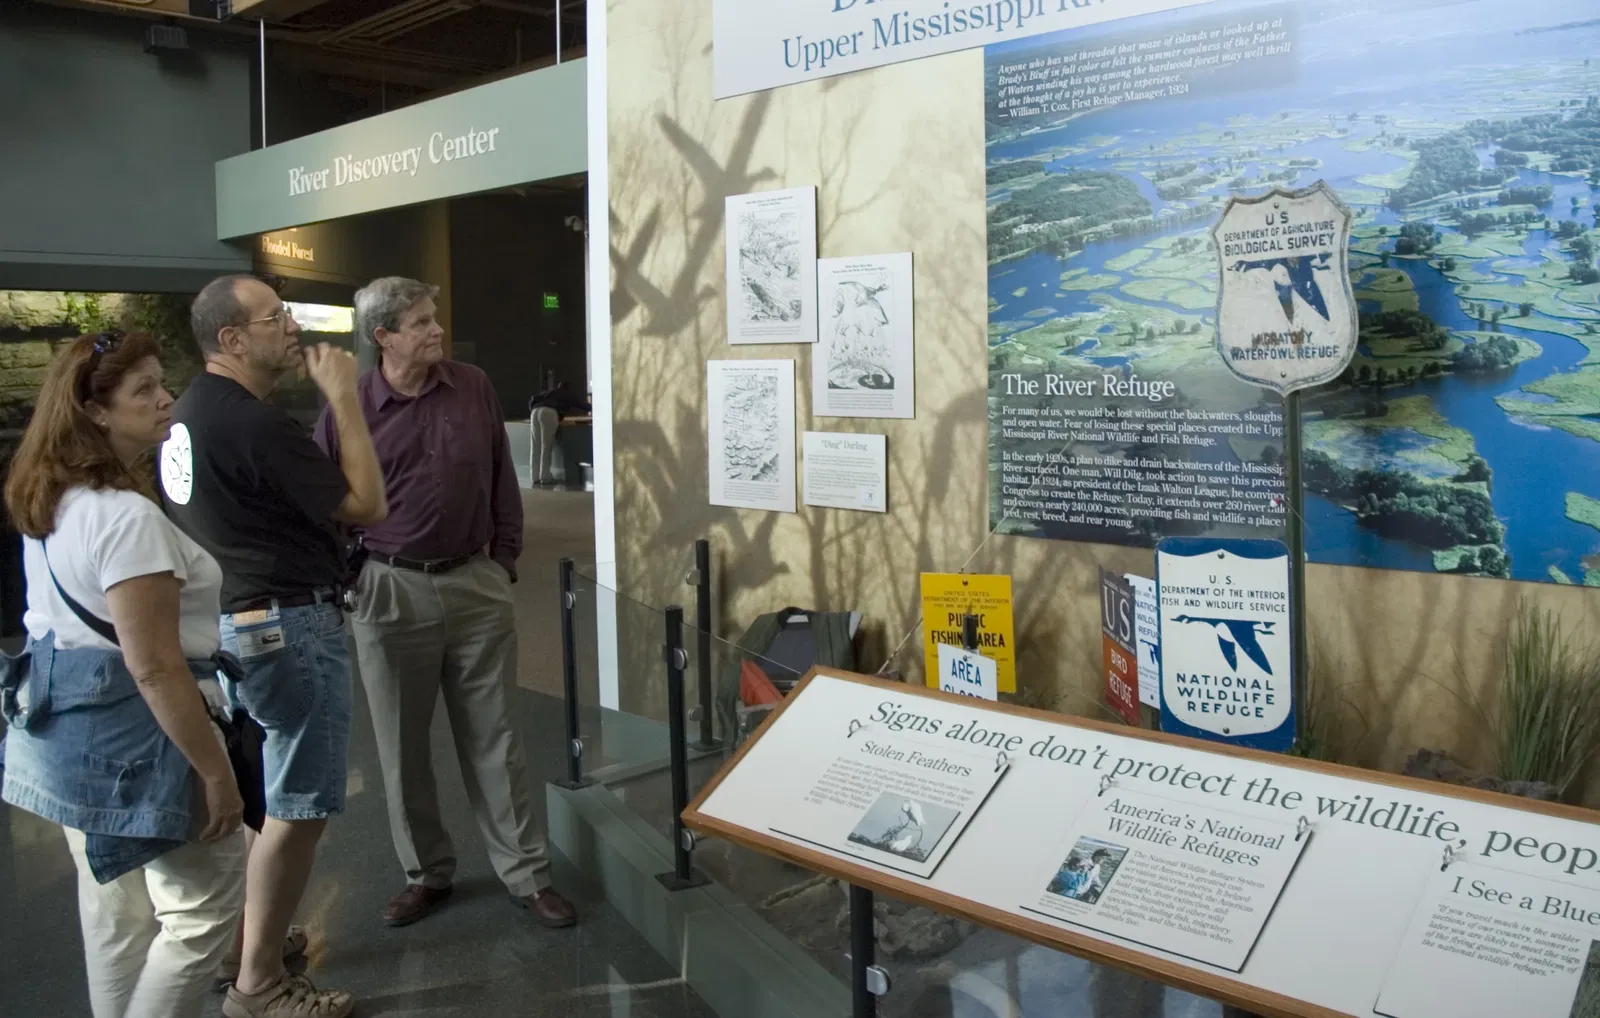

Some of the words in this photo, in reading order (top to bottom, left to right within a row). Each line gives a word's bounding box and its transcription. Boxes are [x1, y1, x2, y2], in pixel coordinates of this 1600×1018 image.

[782, 30, 864, 71] Upper
[998, 64, 1026, 75] Anyone
[1029, 59, 1044, 68] who
[1046, 56, 1061, 66] has
[1064, 54, 1077, 63] not
[1079, 48, 1116, 60] threaded
[1118, 44, 1136, 54] that
[1138, 40, 1161, 50] maze
[1164, 36, 1173, 48] of
[1175, 30, 1208, 44] islands
[1210, 30, 1220, 38] or
[1222, 20, 1253, 36] looked
[1256, 20, 1270, 31] up
[1272, 17, 1283, 28] at
[998, 74, 1027, 86] Brady's
[1030, 68, 1049, 80] Bluff
[1051, 67, 1059, 76] in
[1061, 64, 1076, 76] fall
[1078, 61, 1099, 72] color
[1101, 60, 1110, 68] or
[1111, 56, 1126, 68] felt
[1129, 54, 1142, 65] the
[1144, 47, 1183, 62] summer
[1184, 42, 1220, 56] coolness
[1223, 38, 1234, 50] of
[1235, 37, 1250, 47] the
[1252, 31, 1288, 44] Father
[1010, 106, 1040, 118] William
[1041, 104, 1049, 113] T.
[1051, 101, 1070, 112] Cox,
[1072, 98, 1091, 109] First
[1093, 94, 1122, 108] Refuge
[1125, 88, 1166, 102] Manager,
[1169, 83, 1189, 96] 1924
[288, 166, 329, 196] River
[334, 146, 423, 187] Discovery
[429, 126, 499, 164] Center
[1224, 228, 1269, 242] DEPARTMENT
[1271, 227, 1279, 236] OF
[1282, 220, 1335, 235] AGRICULTURE
[1266, 213, 1275, 226] U
[1280, 211, 1289, 224] S
[262, 236, 291, 258] Flooded
[292, 242, 314, 262] Forest
[1224, 240, 1283, 256] BIOLOGICAL
[1288, 232, 1335, 250] SURVEY
[1252, 331, 1312, 346] MIGRATORY
[1230, 346, 1294, 360] WATERFOWL
[1298, 345, 1340, 359] REFUGE
[1001, 374, 1039, 395] The
[1044, 374, 1097, 396] River
[1102, 374, 1175, 400] Refuge
[1002, 406, 1017, 415] For
[1018, 408, 1039, 417] many
[1041, 407, 1050, 416] of
[1050, 409, 1062, 417] us,
[1078, 408, 1102, 417] would
[1105, 408, 1115, 417] be
[1117, 408, 1132, 417] lost
[1135, 408, 1168, 419] without
[1170, 409, 1184, 419] the
[1187, 410, 1242, 421] backwaters,
[1244, 410, 1282, 423] sloughs
[1002, 418, 1016, 427] and
[1018, 420, 1037, 428] open
[1038, 420, 1062, 428] water.
[1064, 418, 1083, 428] Fear
[1084, 419, 1094, 429] of
[1094, 420, 1120, 431] losing
[1121, 421, 1145, 430] these
[1146, 421, 1176, 432] special
[1178, 422, 1206, 434] places
[1208, 424, 1243, 433] created
[1245, 424, 1261, 434] the
[1003, 429, 1046, 440] Mississippi
[1048, 430, 1069, 440] River
[1070, 430, 1105, 441] National
[1106, 431, 1140, 442] Wildlife
[1141, 434, 1158, 443] and
[1160, 434, 1180, 445] Fish
[1182, 434, 1218, 447] Refuge.
[1003, 451, 1011, 460] In
[1012, 452, 1024, 461] the
[1025, 452, 1043, 463] early
[1046, 453, 1069, 464] 1920s,
[1071, 456, 1075, 464] a
[1076, 456, 1093, 466] plan
[1094, 456, 1103, 465] to
[1104, 456, 1121, 466] dike
[1123, 457, 1139, 467] and
[1140, 458, 1162, 468] drain
[1164, 459, 1213, 470] backwaters
[1214, 461, 1224, 471] of
[1225, 462, 1239, 472] the
[1162, 586, 1209, 596] DEPARTMENT
[1213, 588, 1225, 596] OF
[1229, 589, 1243, 598] THE
[1248, 590, 1285, 600] INTERIOR
[1162, 597, 1180, 606] FISH
[1184, 599, 1200, 607] AND
[1206, 600, 1244, 610] WILDLIFE
[1250, 603, 1286, 612] SERVICE
[948, 612, 986, 628] PUIC
[932, 630, 963, 645] FISHIN
[977, 632, 1006, 648] AREA
[952, 658, 982, 686] AREA
[1111, 648, 1128, 674] BIRD
[1109, 670, 1133, 708] REFUGE
[1176, 673, 1275, 691] NATIONAL
[1178, 686, 1275, 705] WILDLIFE
[1188, 702, 1264, 718] REFUGE
[860, 740, 904, 761] Stolen
[905, 751, 972, 777] Feathers
[869, 701, 942, 731] Signs
[945, 720, 1023, 751] alone
[1029, 735, 1111, 770] don't
[1109, 754, 1236, 797] protect
[1242, 778, 1302, 810] the
[1316, 795, 1467, 849] wildlife,
[1480, 829, 1600, 875] peop
[1105, 798, 1195, 830] America's
[1199, 818, 1284, 850] National
[1108, 817, 1177, 846] Wildlife
[1180, 837, 1260, 867] Refuges
[1452, 876, 1464, 894] I
[1468, 880, 1512, 905] See
[1519, 896, 1532, 910] a
[1541, 895, 1600, 925] Blue
[1449, 908, 1463, 916] you
[1465, 910, 1492, 922] travel
[1493, 916, 1519, 930] much
[1521, 923, 1531, 932] in
[1533, 925, 1548, 936] the
[1550, 930, 1580, 944] wilder
